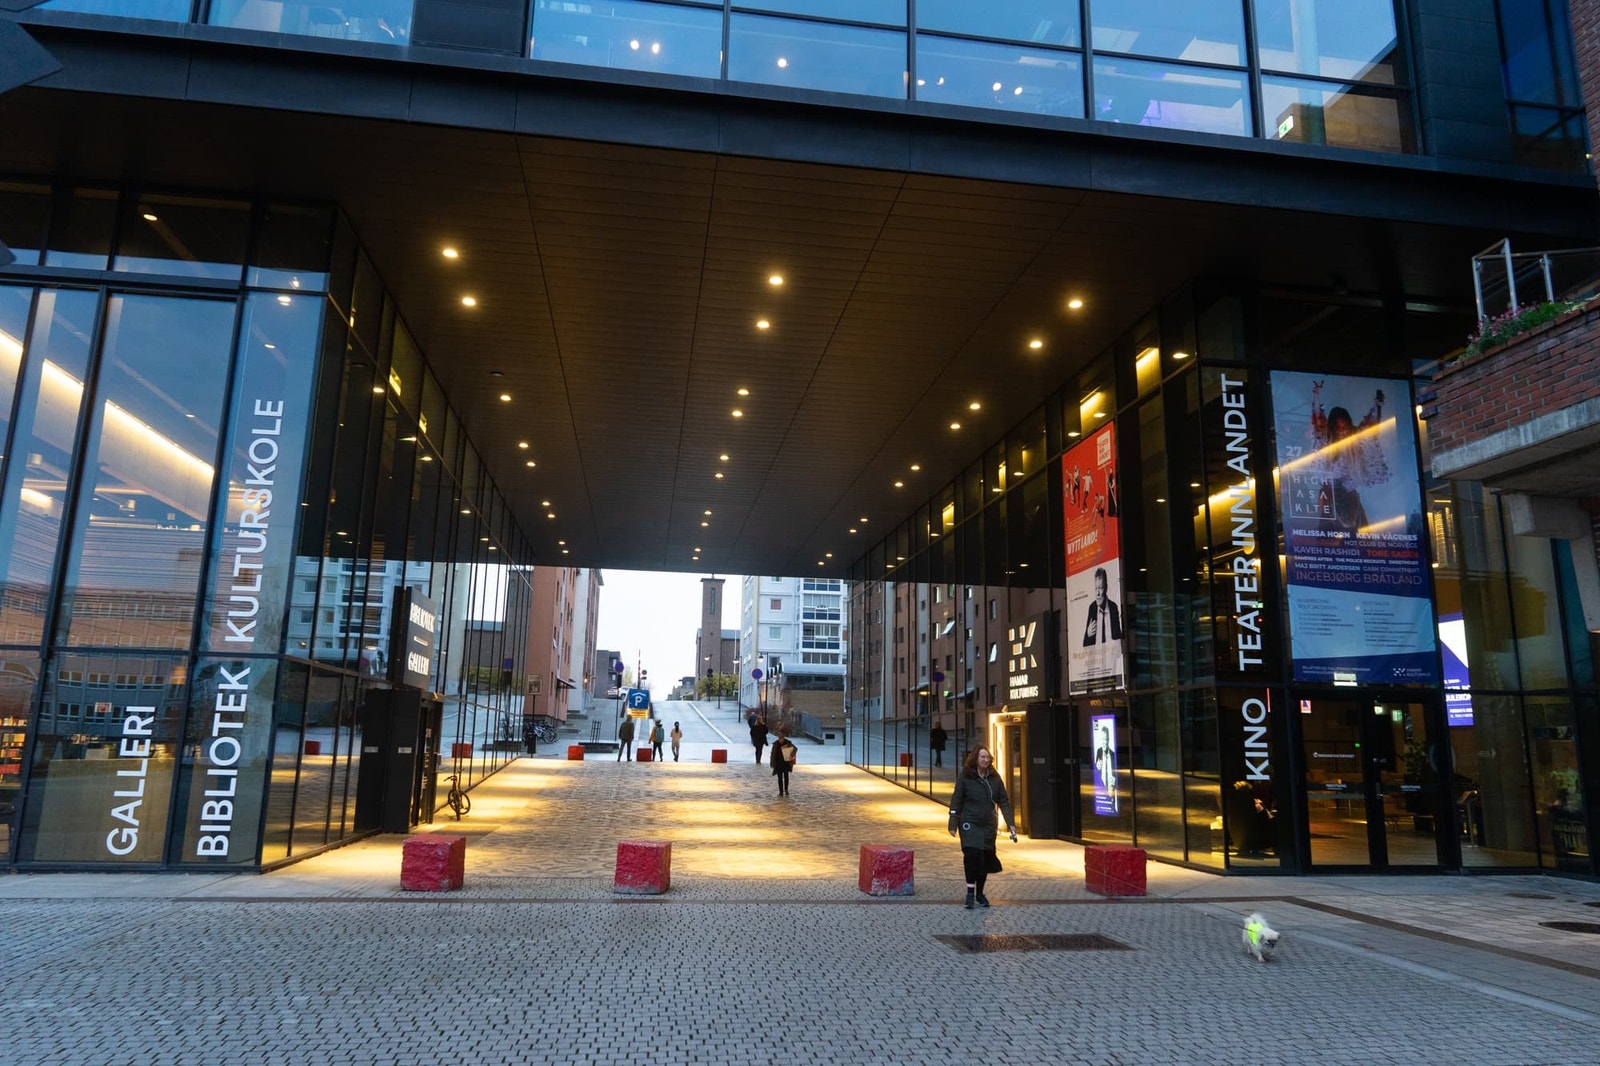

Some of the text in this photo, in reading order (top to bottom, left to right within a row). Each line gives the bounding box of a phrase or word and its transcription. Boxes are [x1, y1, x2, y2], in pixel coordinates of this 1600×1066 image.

[1293, 475, 1329, 485] HIGH
[1294, 503, 1331, 514] KITE
[1292, 528, 1350, 539] MELISSA HORN
[1221, 373, 1270, 782] KINO TEATER INNLANDET
[196, 399, 285, 857] BIBLIOTEK KULTURSKOLE
[634, 695, 643, 707] P
[106, 705, 155, 856] GALLERI
